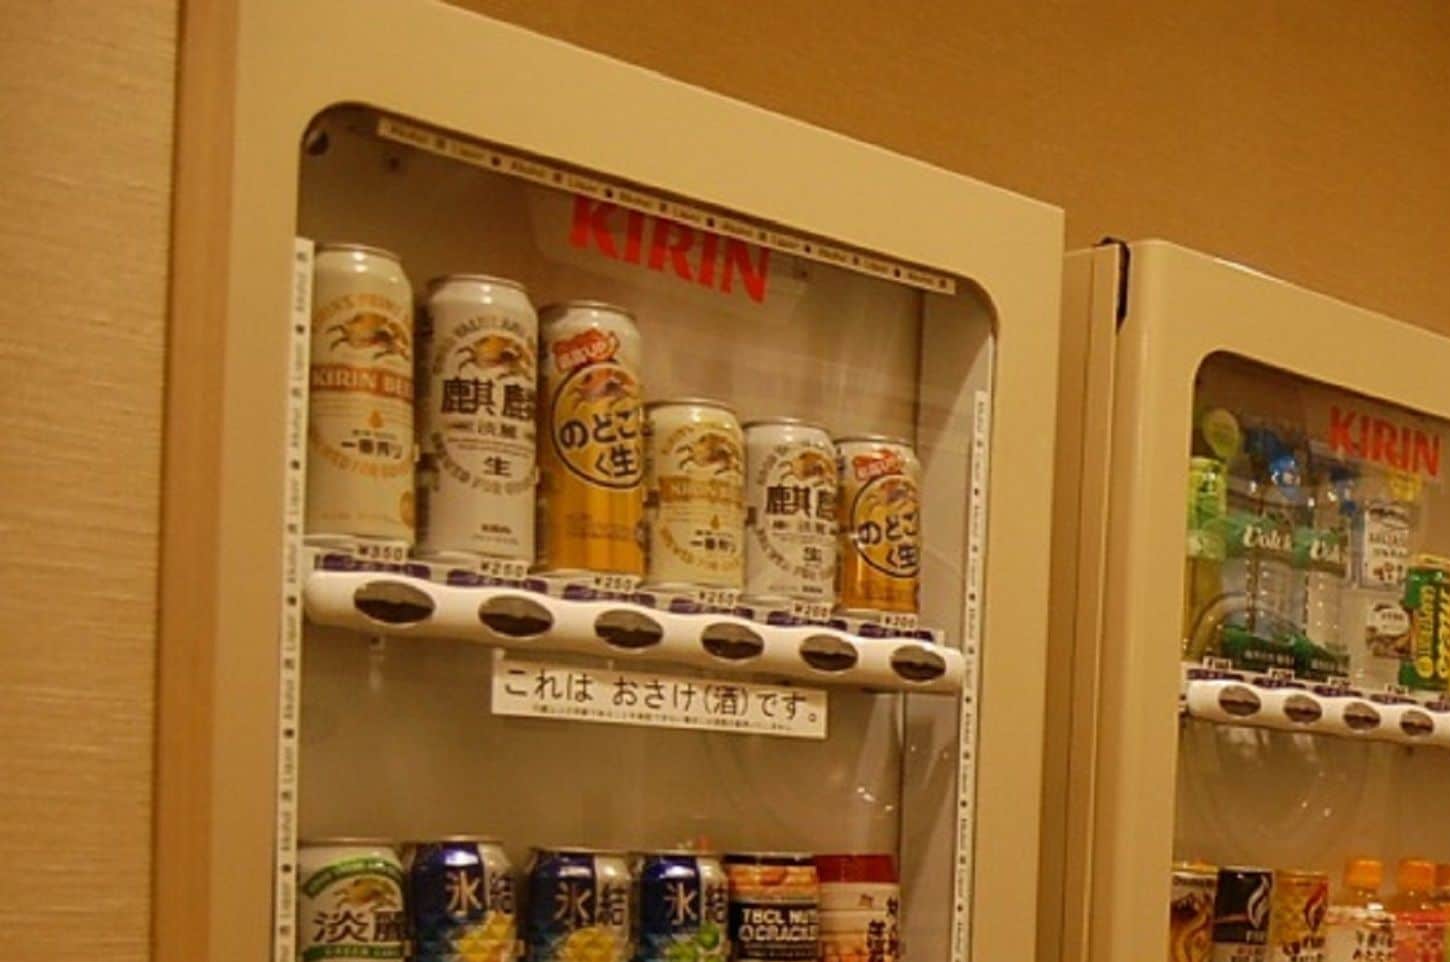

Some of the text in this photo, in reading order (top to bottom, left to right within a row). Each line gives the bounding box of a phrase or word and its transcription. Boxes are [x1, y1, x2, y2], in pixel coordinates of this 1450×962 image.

[568, 193, 770, 305] KIRIN
[311, 367, 377, 389] KIRIN
[1328, 405, 1441, 477] KIRIN
[505, 668, 594, 702] これは
